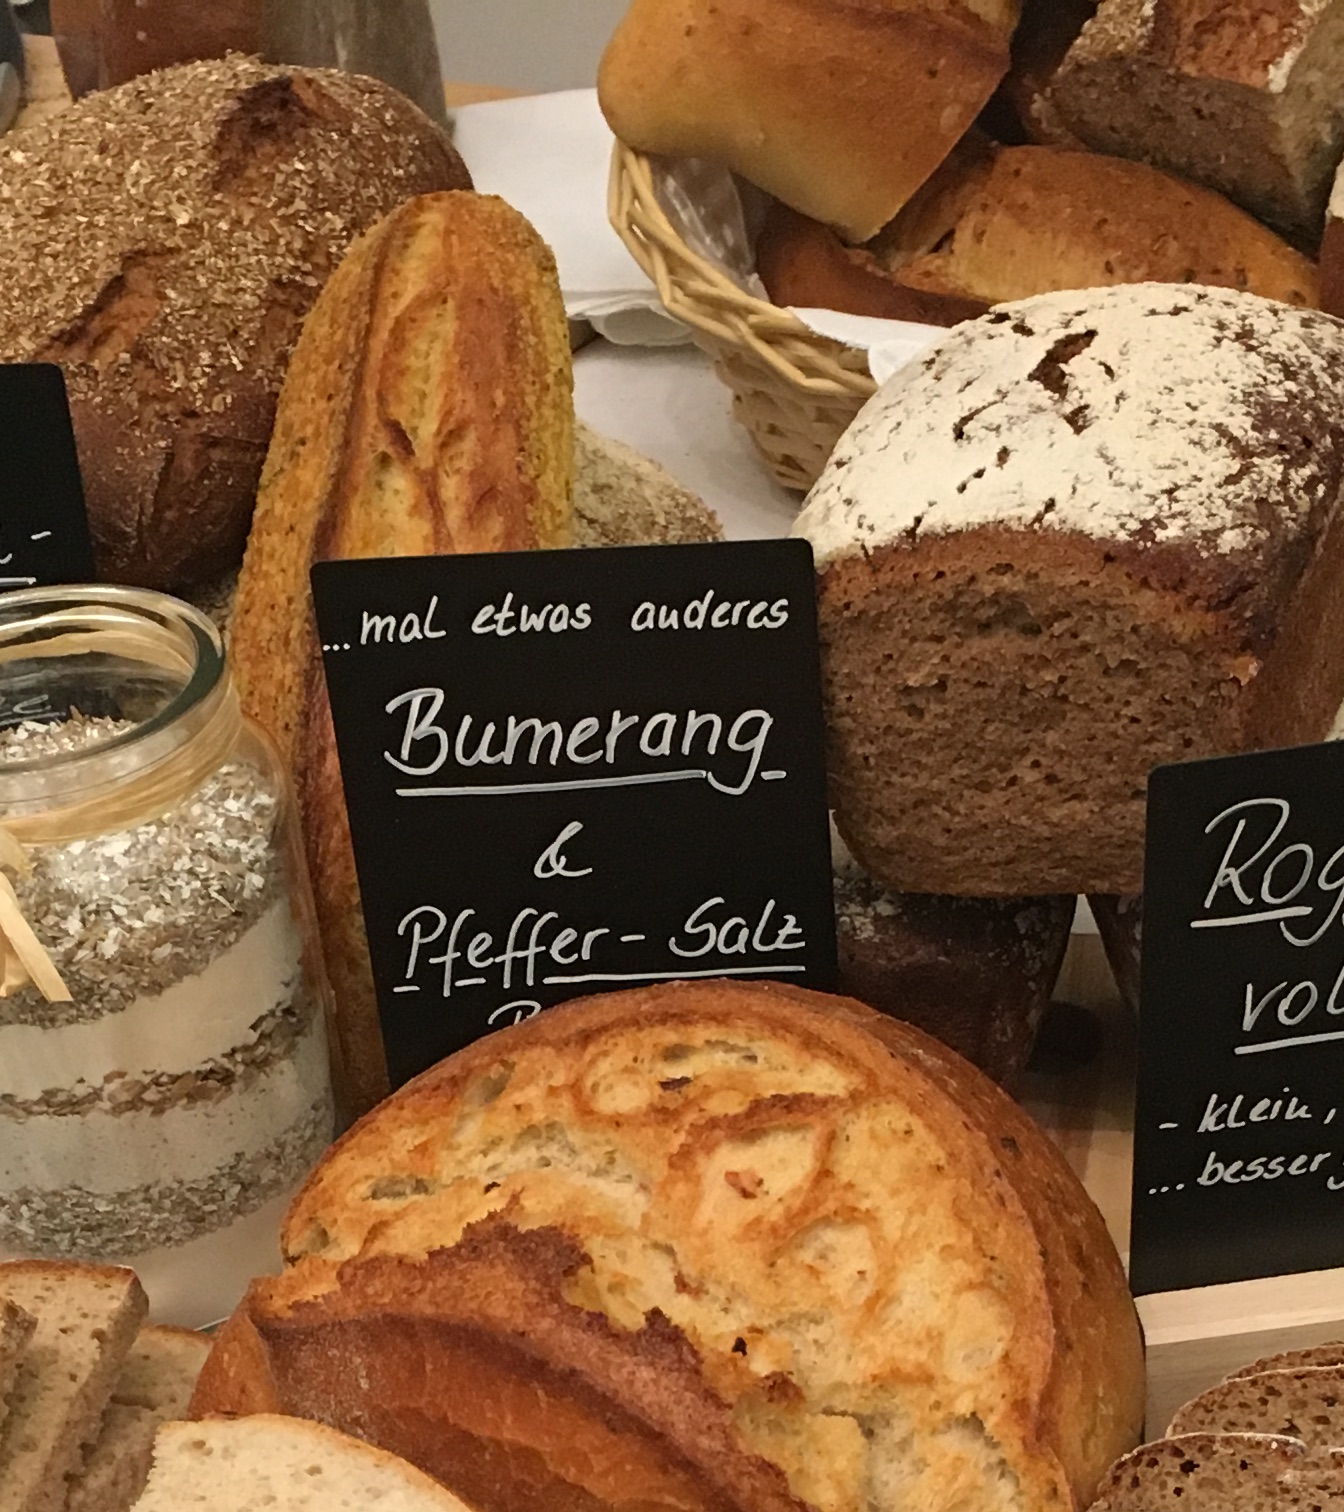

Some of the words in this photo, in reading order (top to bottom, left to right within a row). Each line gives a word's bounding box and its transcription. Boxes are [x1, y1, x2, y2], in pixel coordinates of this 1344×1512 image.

[471, 592, 593, 638] etwas
[383, 687, 775, 796] Bumerang
[533, 820, 593, 879] &
